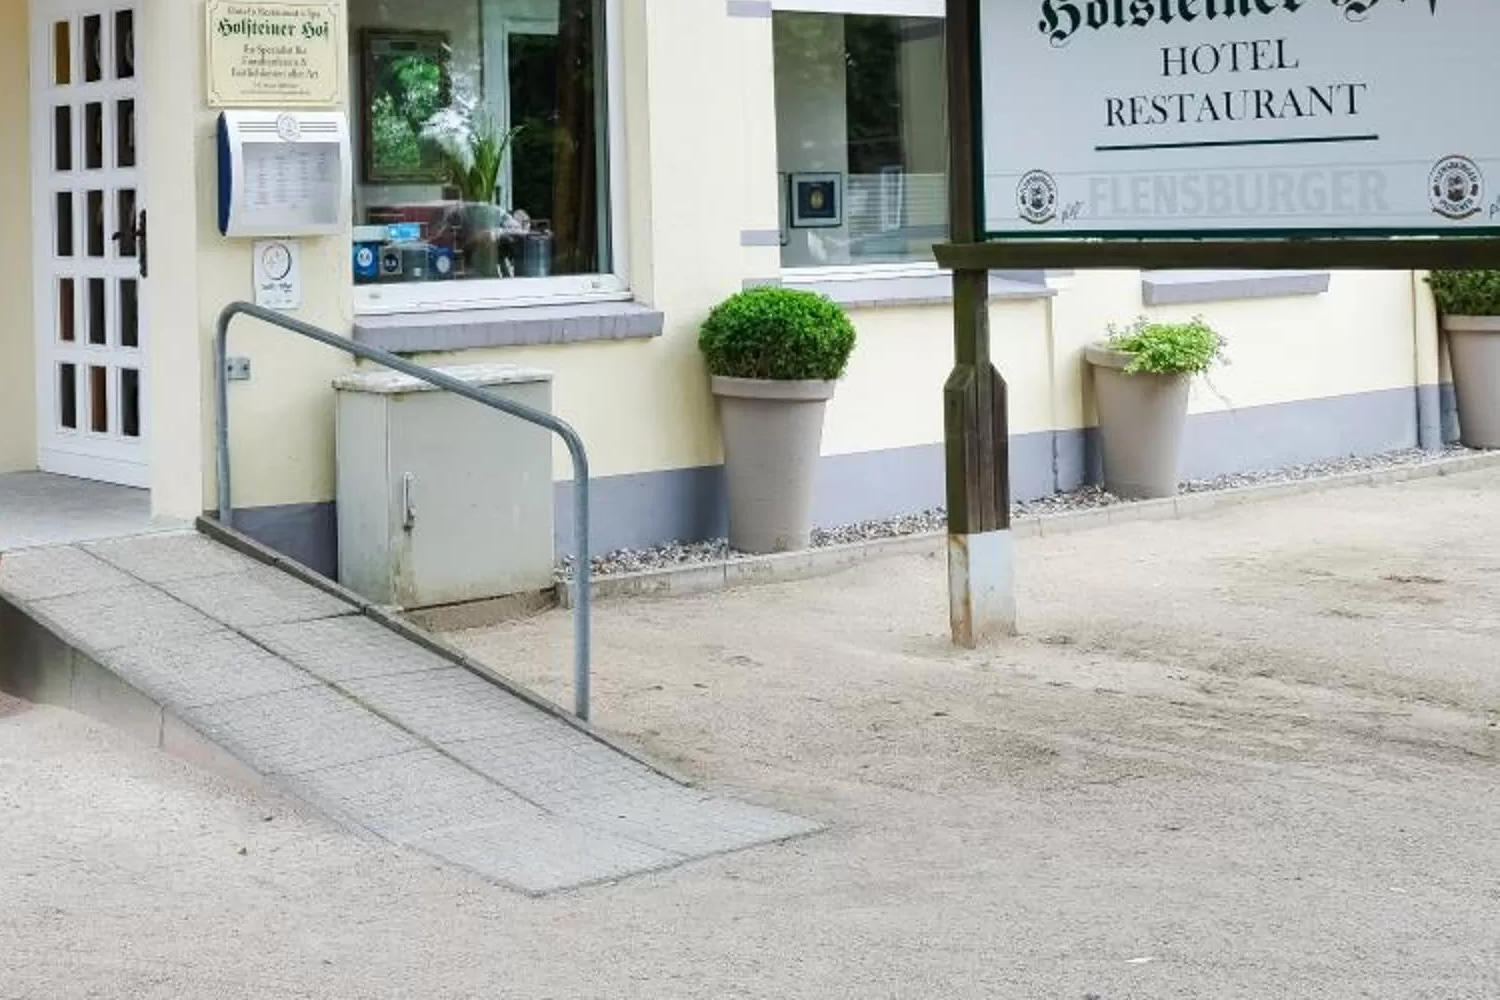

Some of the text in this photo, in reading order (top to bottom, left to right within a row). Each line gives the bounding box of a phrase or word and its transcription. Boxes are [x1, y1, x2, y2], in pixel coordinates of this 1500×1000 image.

[1160, 37, 1299, 77] HOTEL
[1104, 83, 1368, 128] RESTAURANT
[1089, 168, 1390, 217] FLENSBURGER
